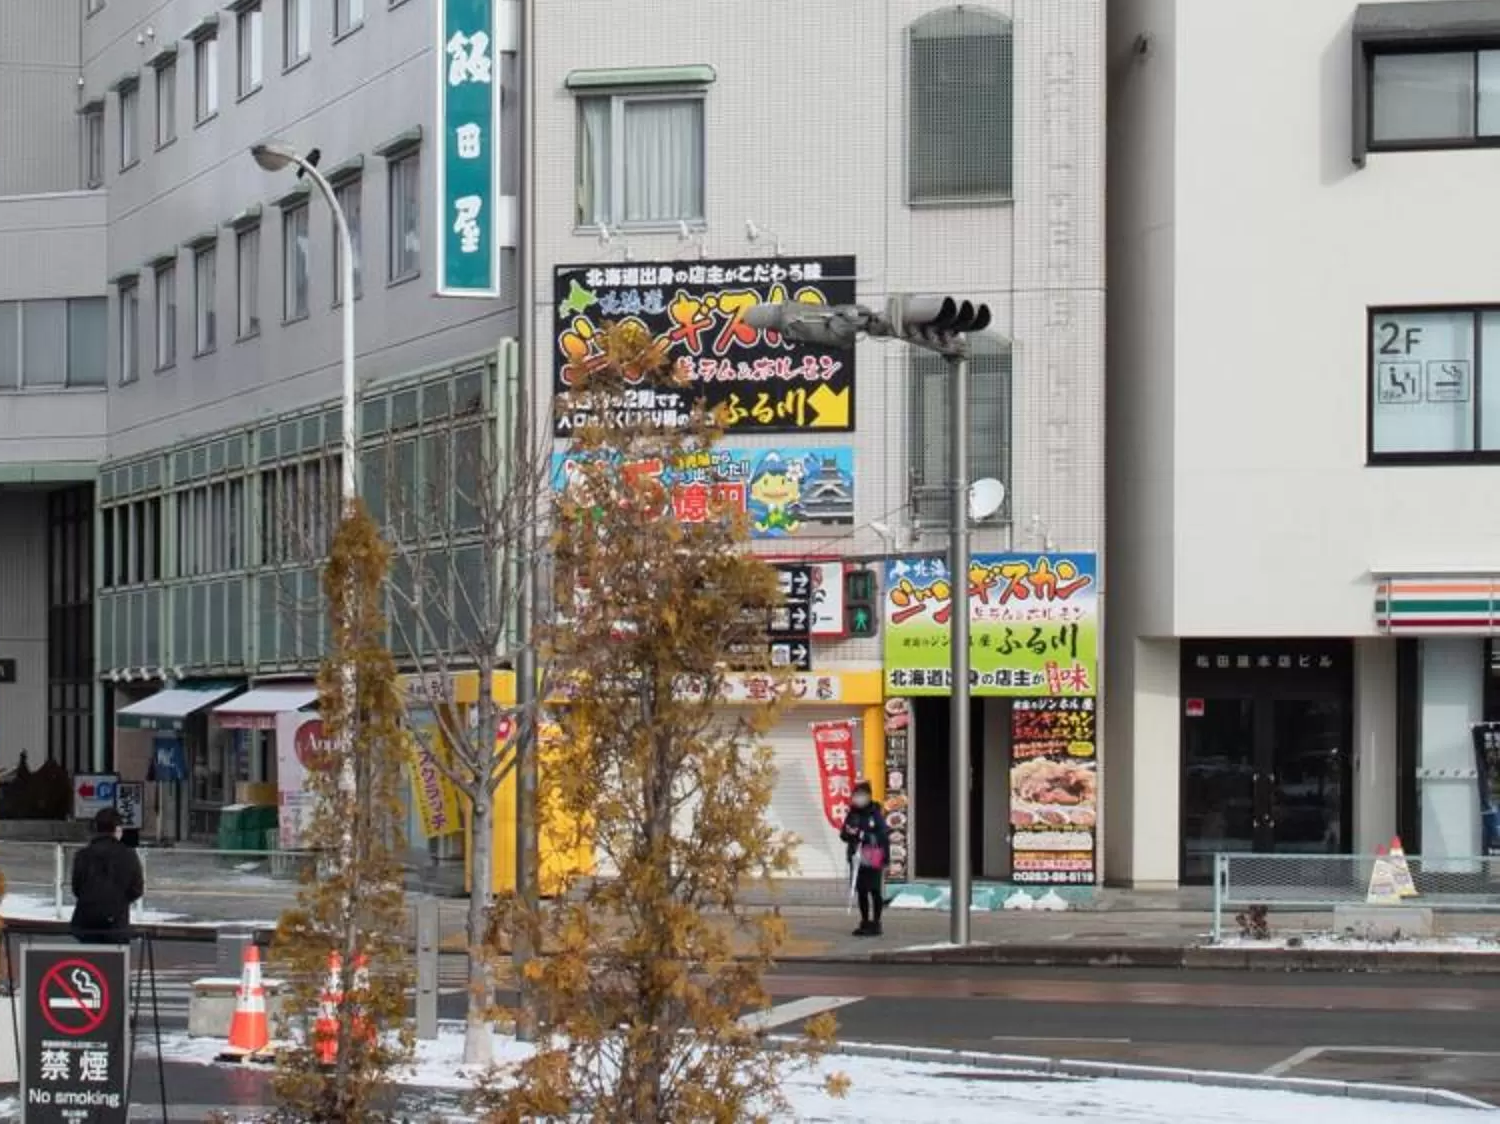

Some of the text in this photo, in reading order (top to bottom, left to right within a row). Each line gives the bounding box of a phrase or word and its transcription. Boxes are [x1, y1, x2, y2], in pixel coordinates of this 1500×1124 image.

[446, 30, 492, 254] 飯田屋
[1379, 321, 1423, 355] 2F
[40, 1049, 109, 1082] 禁煙
[28, 1088, 120, 1108] No smoking
